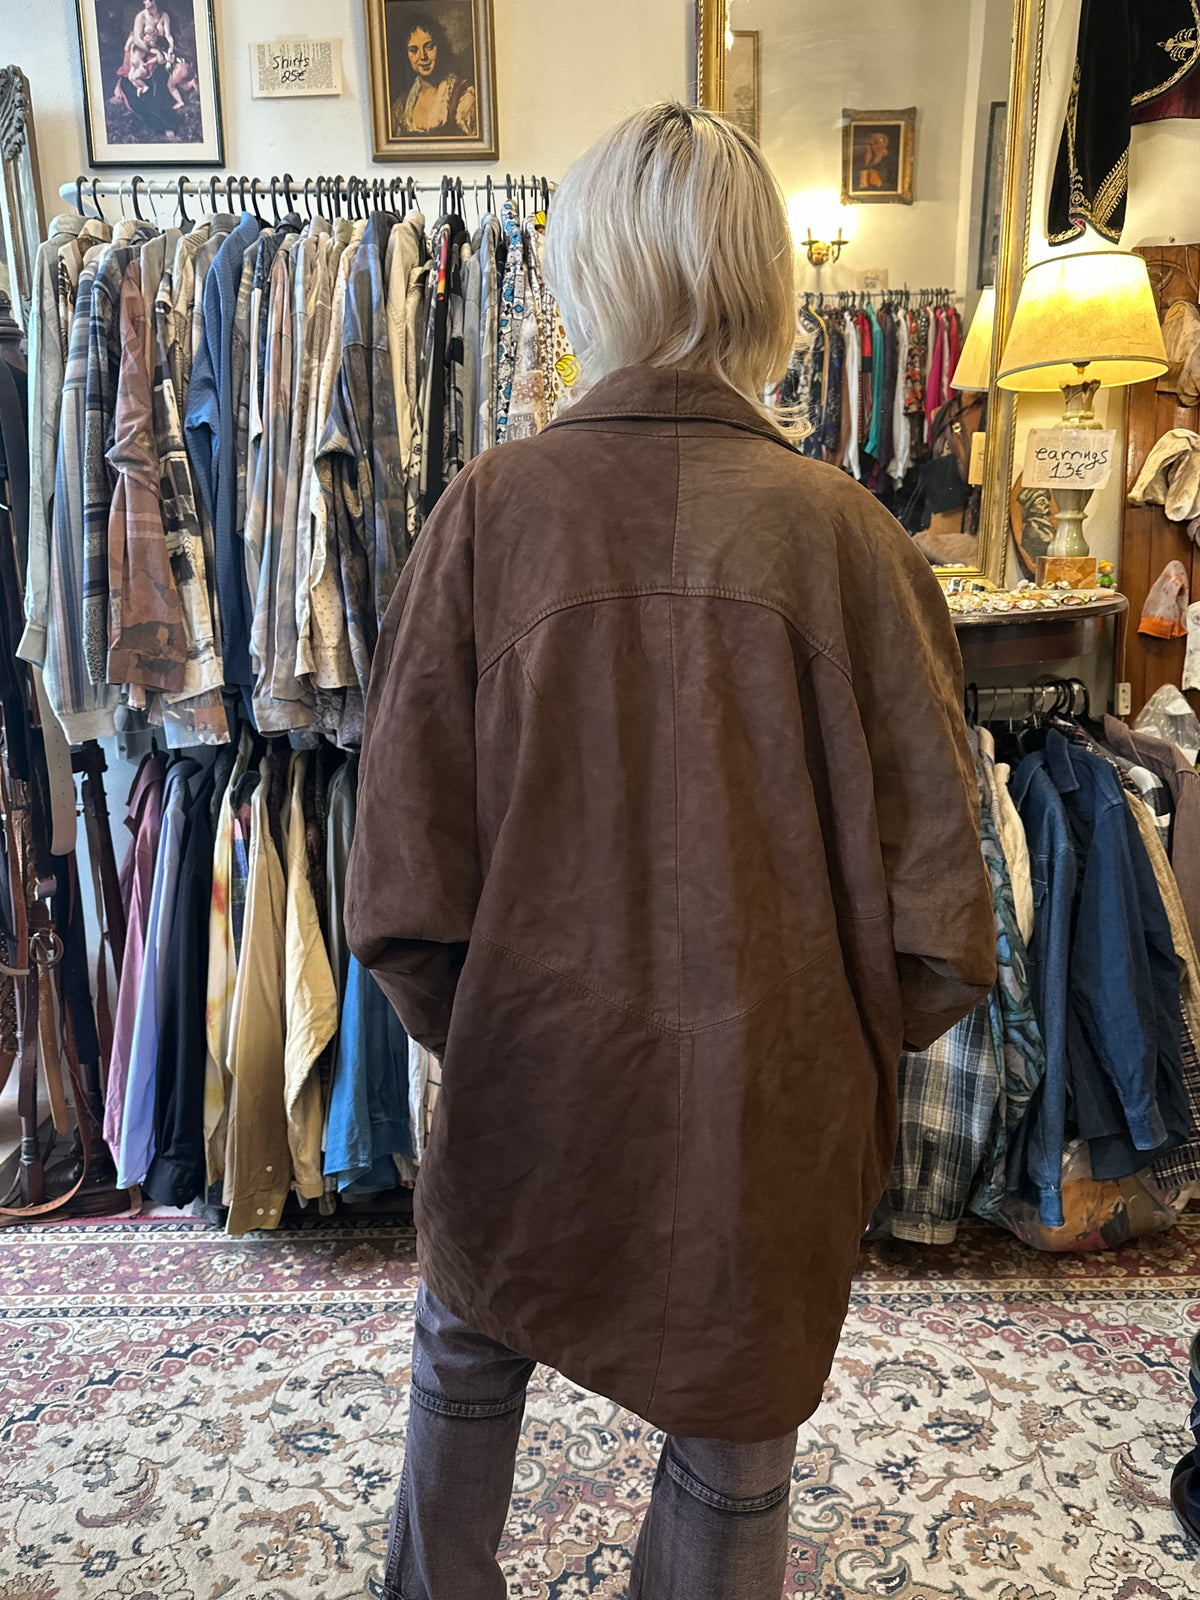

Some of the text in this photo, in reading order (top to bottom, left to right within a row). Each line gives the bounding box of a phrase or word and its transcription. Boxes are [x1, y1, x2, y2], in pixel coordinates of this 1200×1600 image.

[272, 52, 310, 70] Shirts
[1034, 447, 1109, 470] earrings
[1048, 461, 1085, 479] 13€
